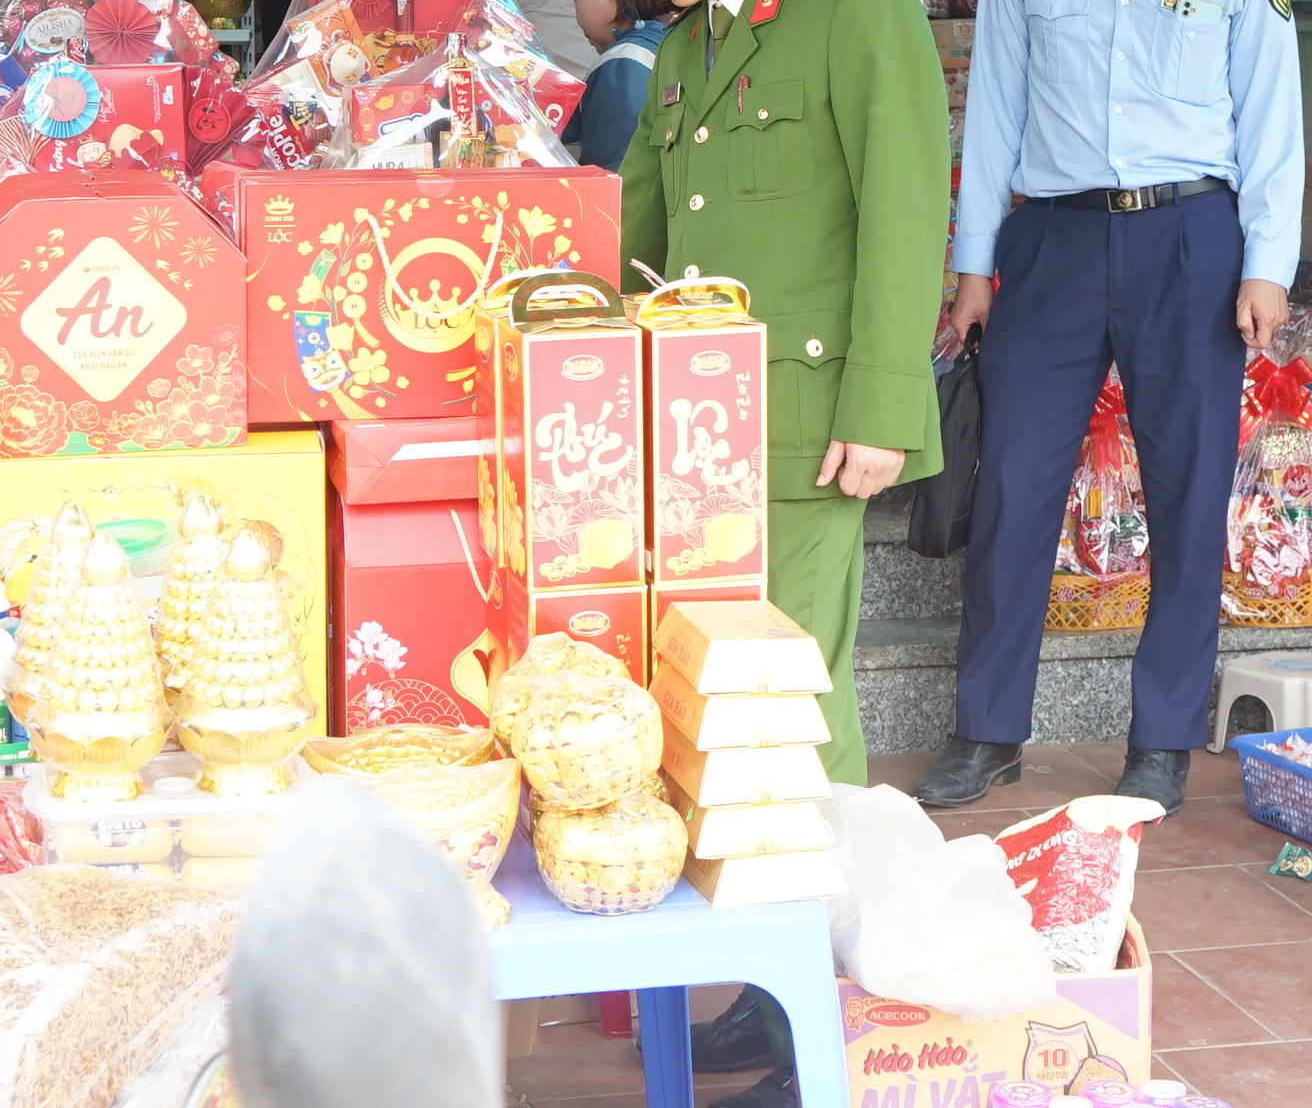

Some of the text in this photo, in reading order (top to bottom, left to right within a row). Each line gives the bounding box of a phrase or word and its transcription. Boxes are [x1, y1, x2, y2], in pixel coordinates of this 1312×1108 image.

[267, 228, 293, 245] LỘC
[56, 276, 154, 345] An
[411, 302, 461, 337] LỘC
[863, 1037, 968, 1076] Hảo Hảo
[1037, 1047, 1070, 1068] 10
